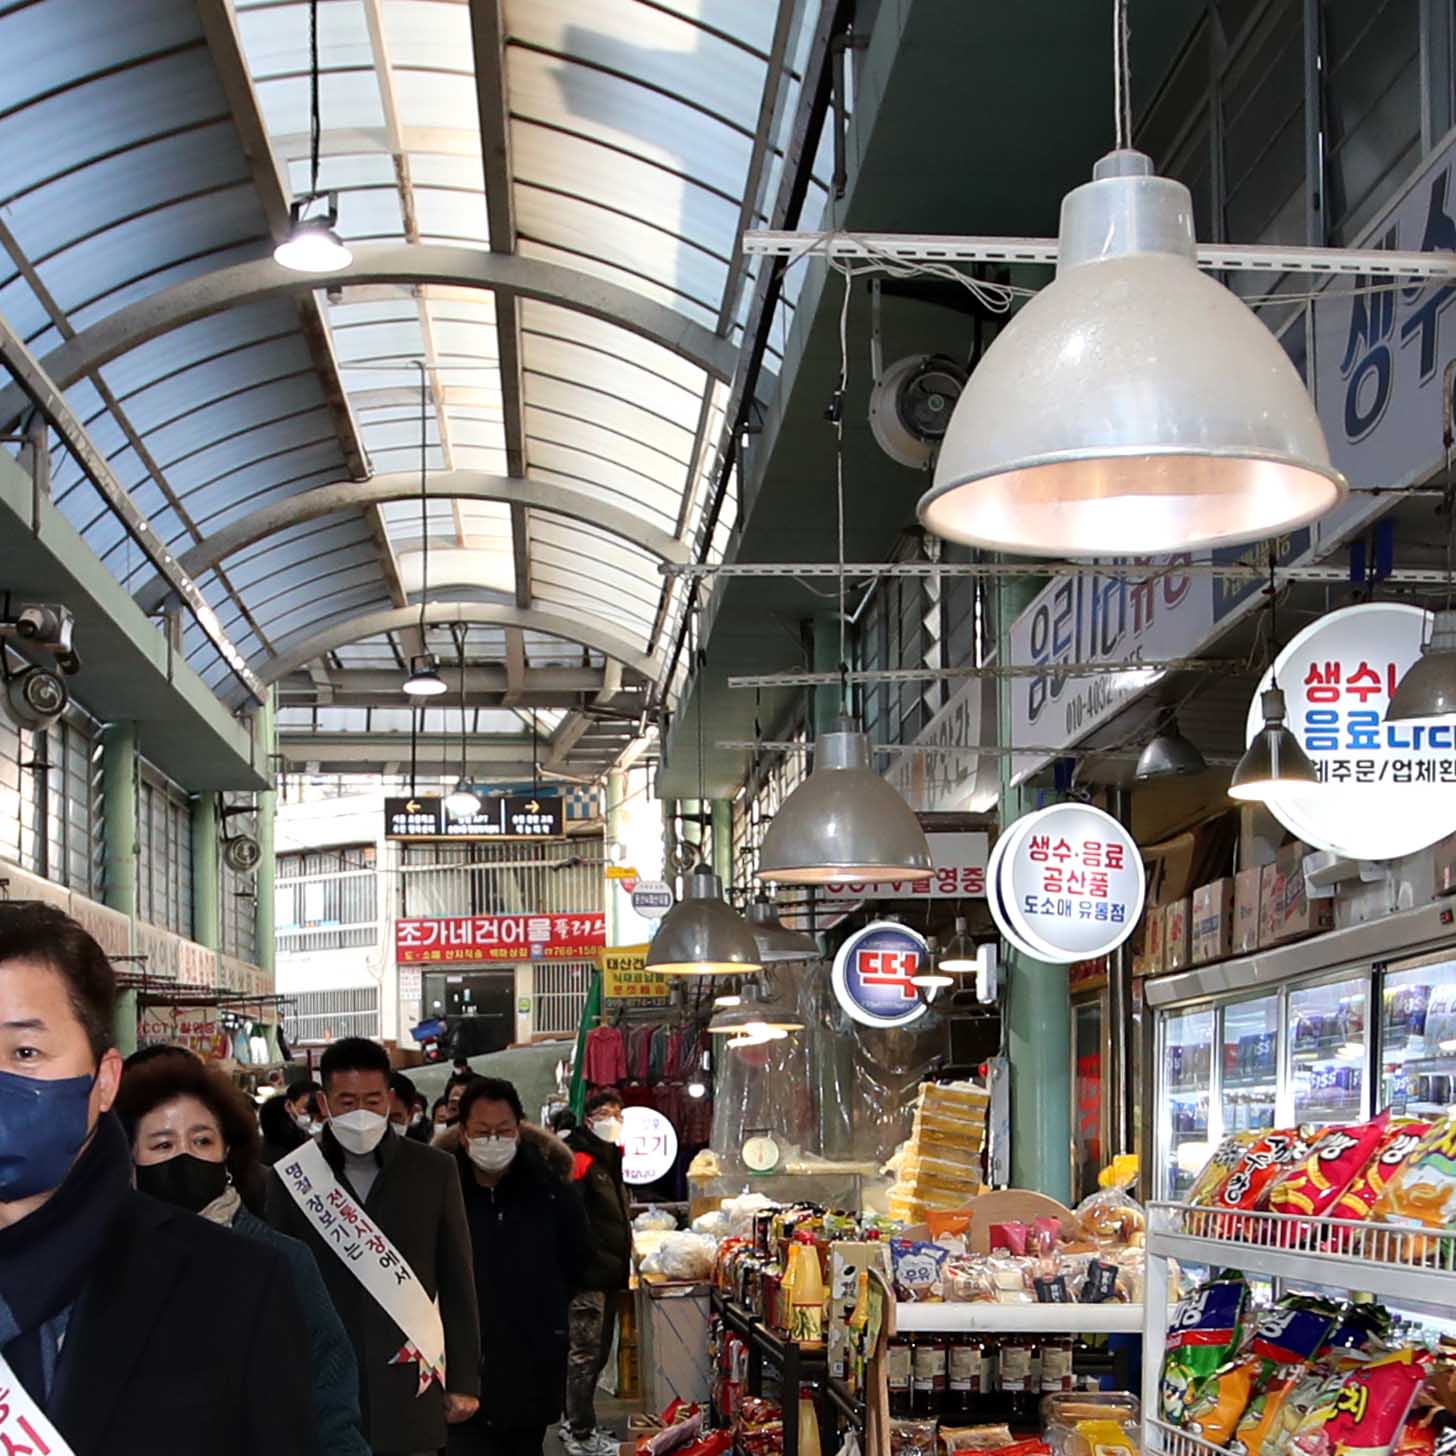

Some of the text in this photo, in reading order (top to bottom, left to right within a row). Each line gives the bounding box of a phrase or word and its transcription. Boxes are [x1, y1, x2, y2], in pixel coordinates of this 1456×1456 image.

[1302, 660, 1396, 705] 생수
[1027, 832, 1126, 873] 생수·음료
[1041, 866, 1111, 899] 공산품
[1022, 896, 1128, 923] 도소매 유통점
[397, 917, 552, 947] 조가네건어물
[856, 949, 919, 1001] 떡
[284, 1160, 364, 1262] 명절 장보기는
[325, 1189, 412, 1286] 전통시장에서
